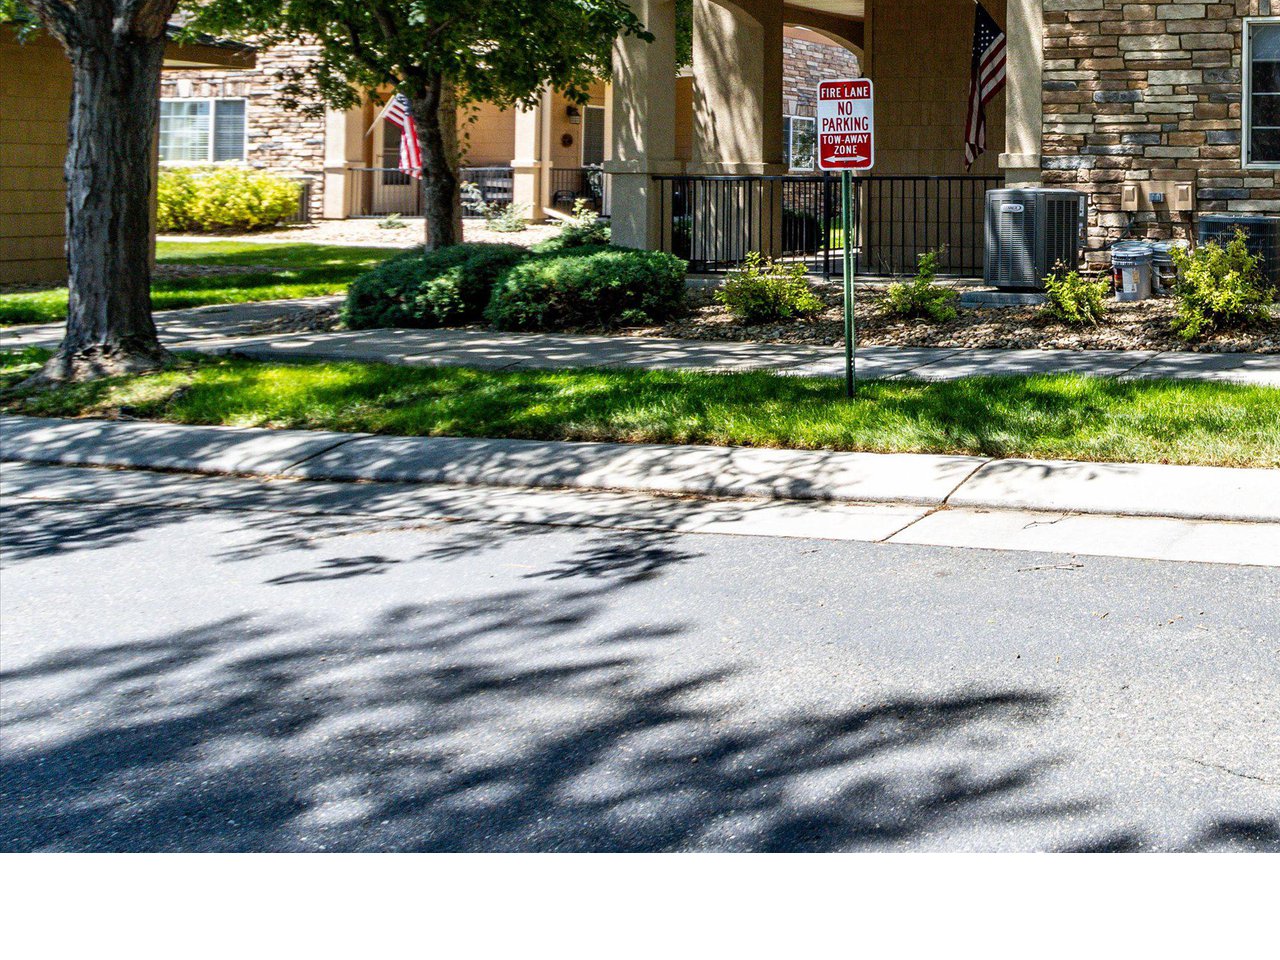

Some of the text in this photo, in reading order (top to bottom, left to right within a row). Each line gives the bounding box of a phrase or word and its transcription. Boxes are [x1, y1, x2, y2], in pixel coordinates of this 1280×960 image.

[821, 87, 868, 98] FIRE LANE
[837, 101, 852, 115] NO
[822, 117, 868, 131] PARKING
[823, 135, 868, 144] TOW-AWAY
[834, 145, 857, 154] ZONE
